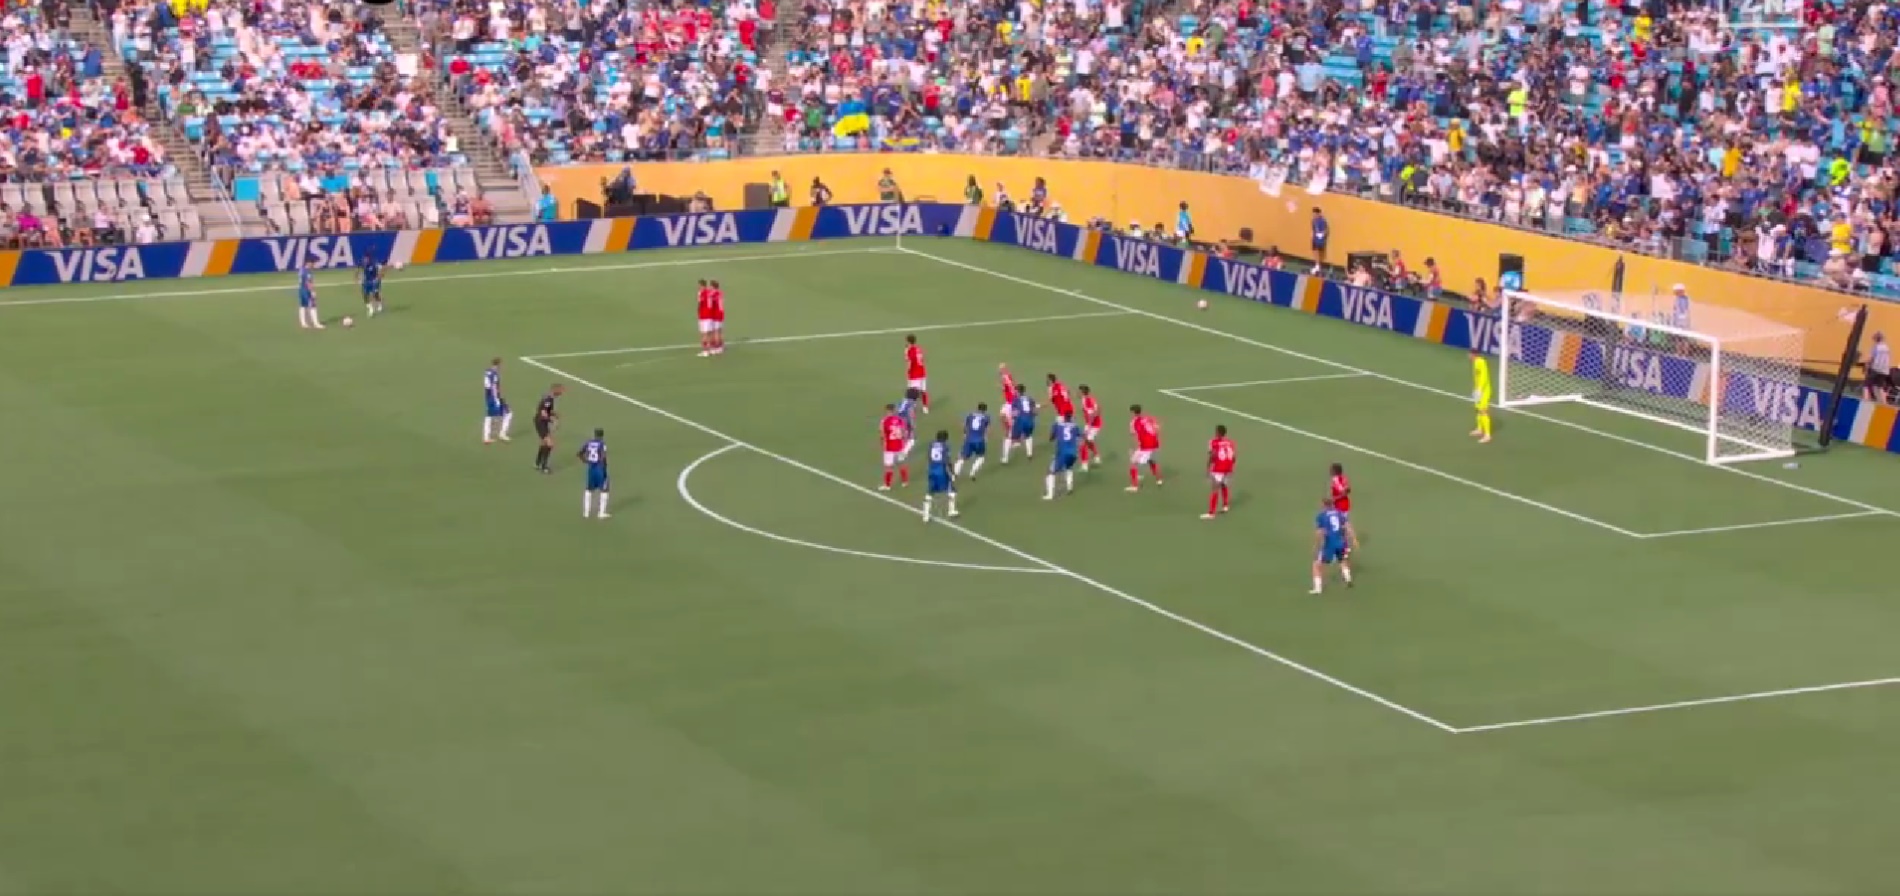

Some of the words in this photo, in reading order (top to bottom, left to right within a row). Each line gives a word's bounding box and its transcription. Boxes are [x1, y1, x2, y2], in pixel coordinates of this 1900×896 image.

[661, 213, 739, 246] VISA
[838, 204, 924, 235] VISA
[1013, 213, 1057, 254] VISA
[260, 236, 353, 271] VISA
[467, 225, 551, 258] VISA
[1113, 237, 1160, 277] VISA
[45, 248, 144, 282] VISA
[1221, 260, 1272, 303] VISA
[1337, 285, 1393, 330] VISA
[1751, 376, 1823, 432] VISA
[1329, 515, 1340, 532] 9
